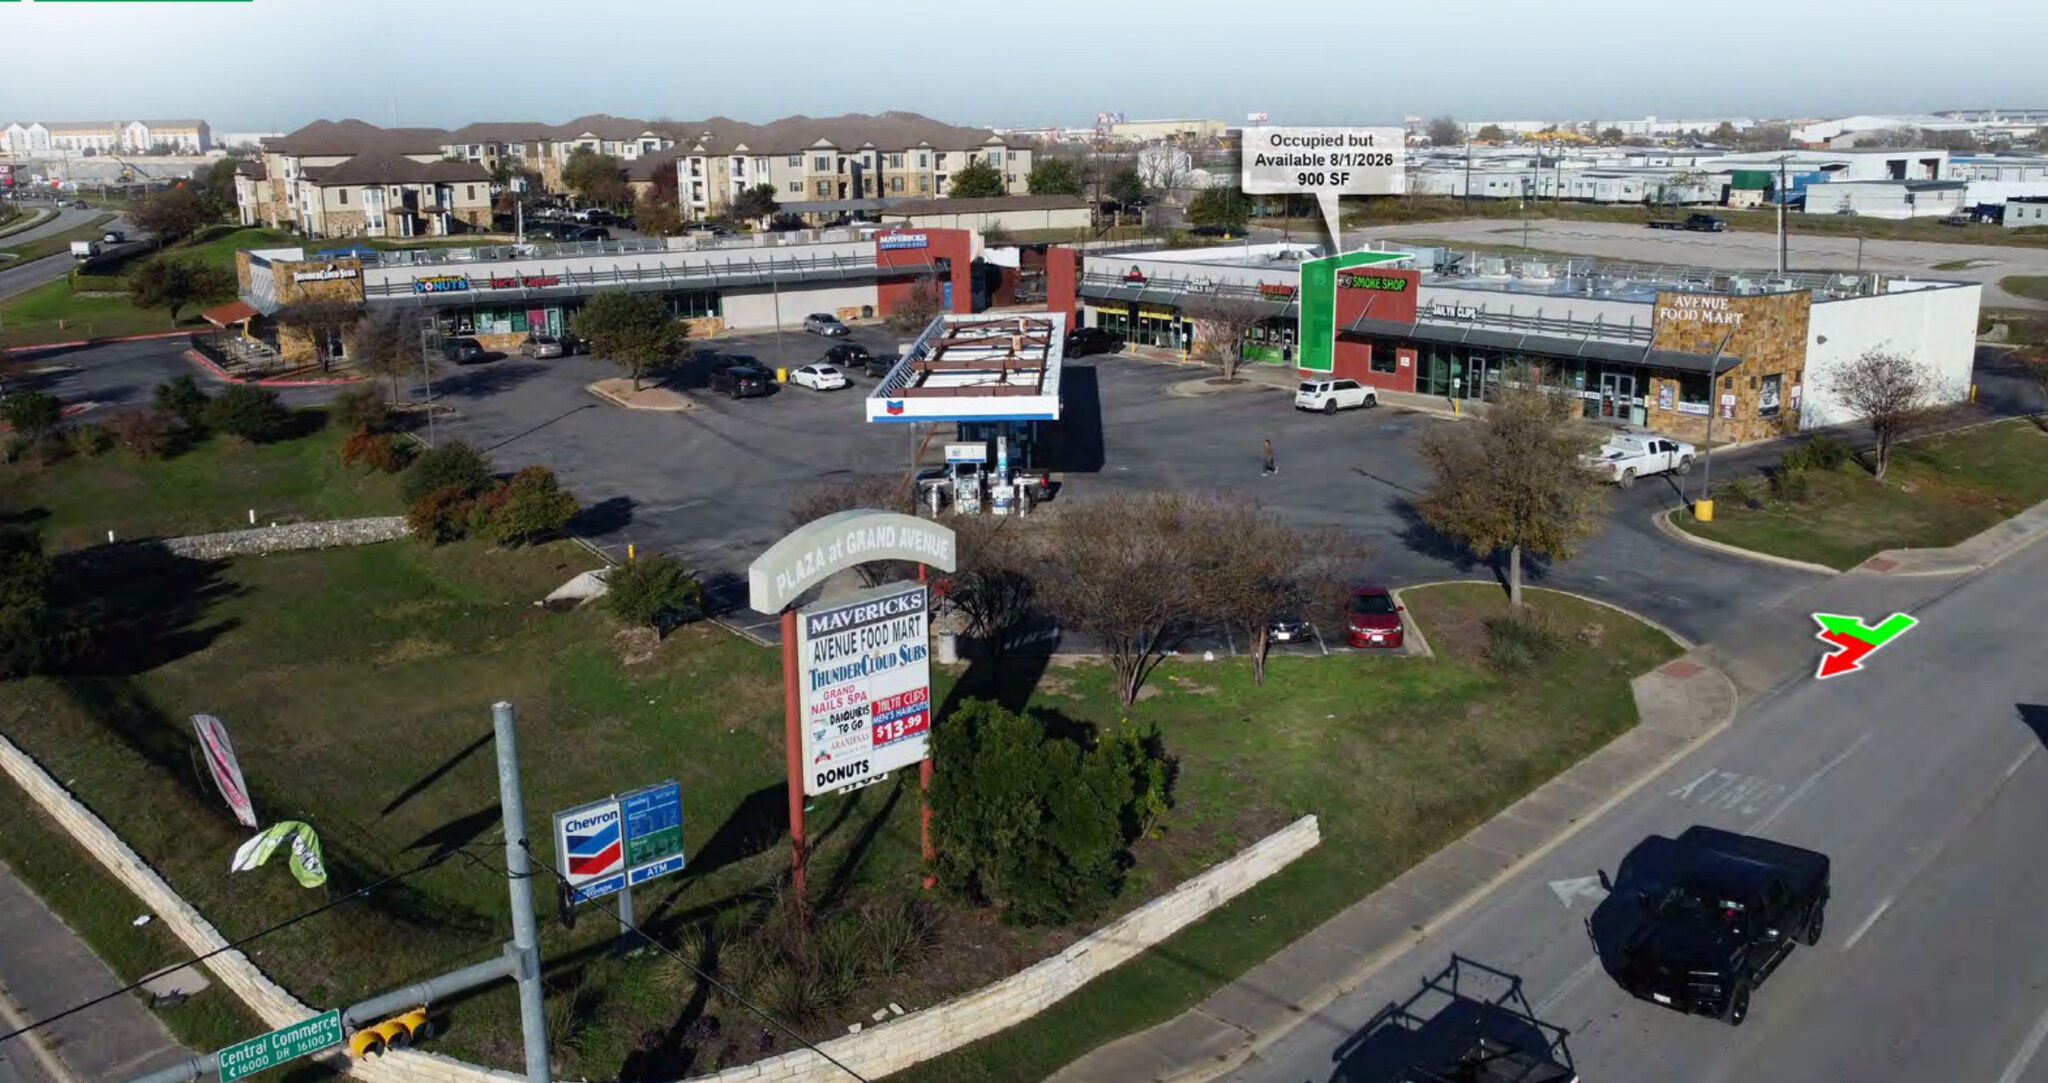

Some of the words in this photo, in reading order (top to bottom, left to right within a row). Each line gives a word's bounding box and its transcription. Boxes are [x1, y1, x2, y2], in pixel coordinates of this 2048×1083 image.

[880, 234, 927, 243] MAVERICKS
[415, 280, 466, 292] DONUTS
[1353, 276, 1381, 289] SMOKE
[1382, 278, 1406, 291] SHOP
[1674, 295, 1728, 310] AVENUE
[1661, 307, 1698, 320] FOOD
[1701, 310, 1744, 325] MART
[776, 547, 826, 598] PLAZA
[828, 537, 844, 562] at
[846, 525, 896, 554] GRAND
[899, 527, 950, 561] AVENUE
[811, 594, 922, 635] MAVERICKS
[813, 631, 858, 664] AVENUE
[861, 623, 889, 652] FOOD
[892, 615, 922, 643] MART
[809, 653, 897, 692] THUNDERCLOUD
[899, 643, 927, 667] SUBS
[811, 697, 843, 716] NAILS
[847, 691, 868, 705] SPA
[823, 684, 855, 701] GRAND
[903, 688, 926, 705] CLIPS
[829, 704, 870, 726] DAIQUIRIS
[872, 710, 894, 724] MEN'S
[895, 701, 928, 717] HAIRCUTS
[837, 723, 850, 735] TO
[851, 719, 864, 731] GO
[876, 714, 922, 739] $13.99
[816, 759, 870, 788] DONUTS
[565, 810, 618, 833] Chevron
[647, 864, 668, 877] ATM
[220, 1037, 268, 1068] Central
[271, 1014, 338, 1049] Commerce
[237, 1056, 270, 1075] 16000
[276, 1048, 290, 1061] DR
[297, 1035, 326, 1052] 16100
